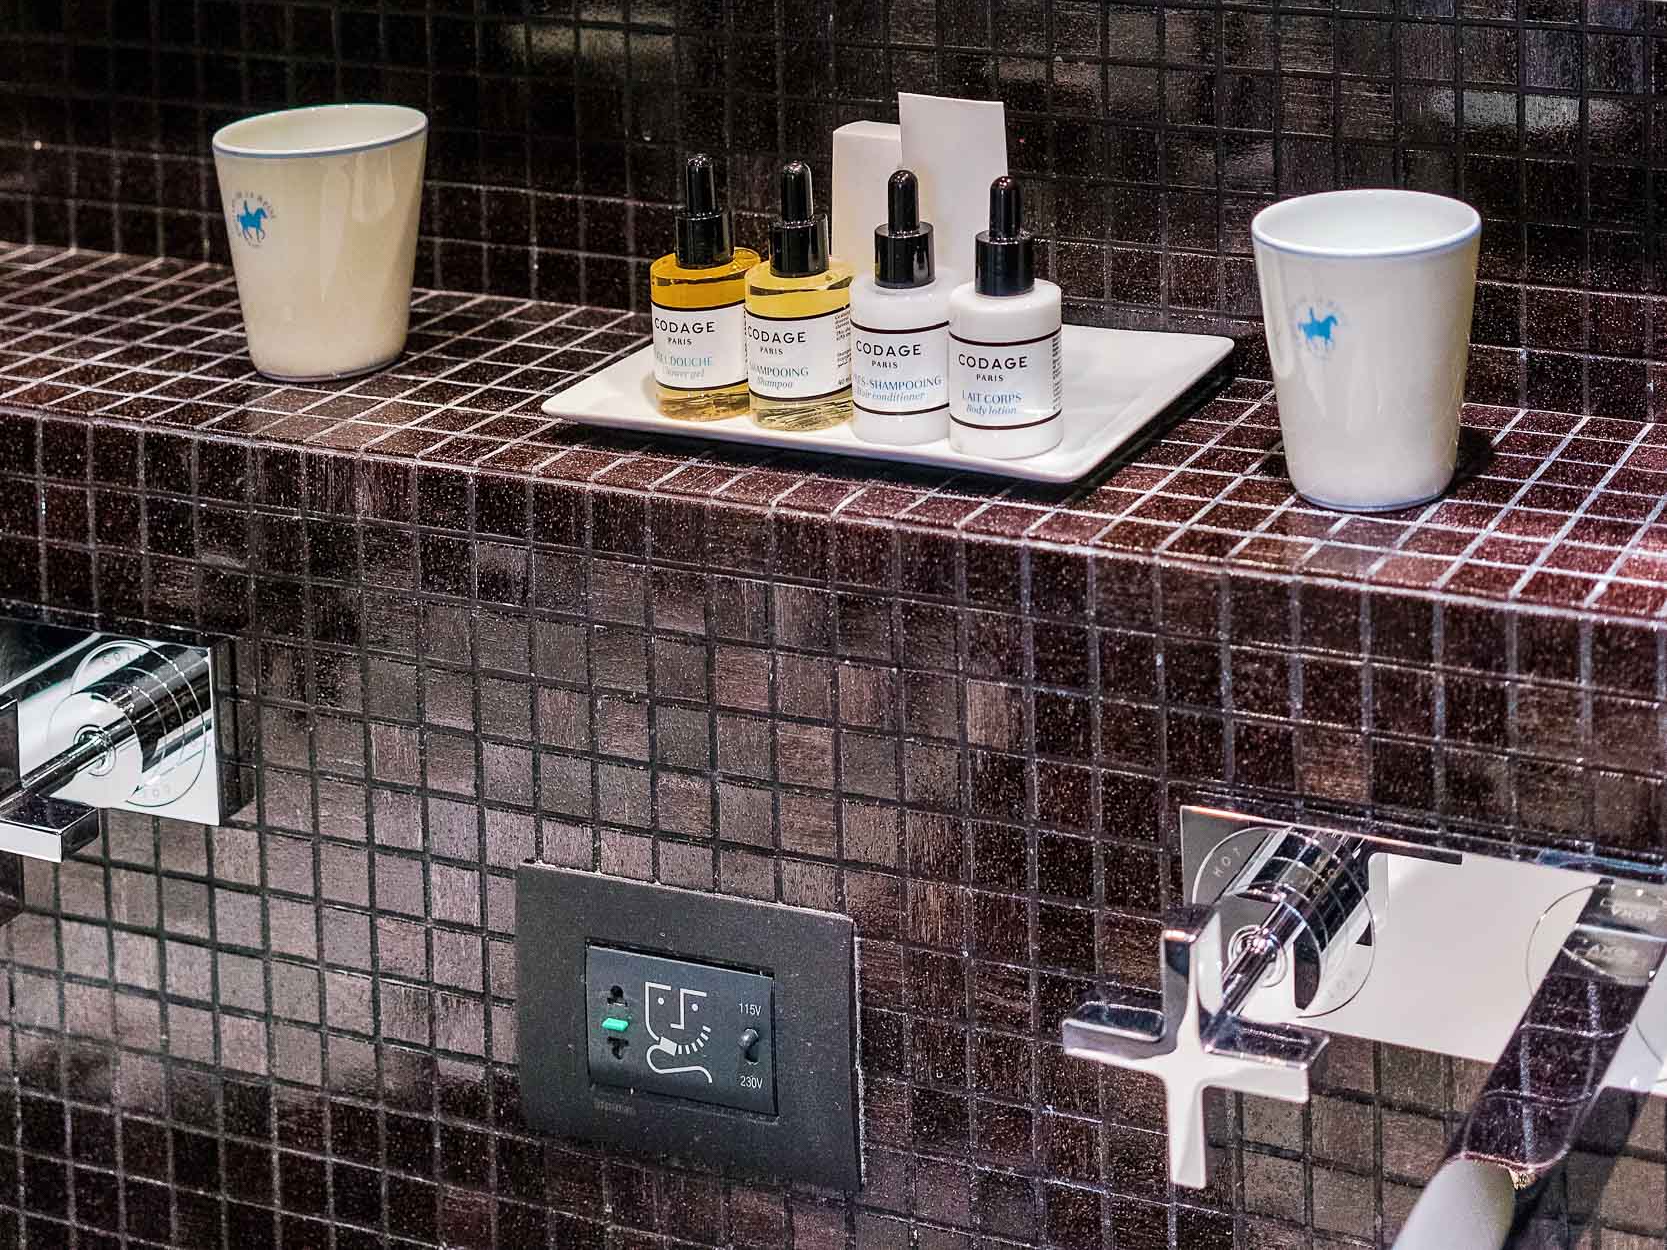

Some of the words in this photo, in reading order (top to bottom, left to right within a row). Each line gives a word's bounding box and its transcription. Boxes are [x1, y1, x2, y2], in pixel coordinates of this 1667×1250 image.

[654, 318, 716, 334] CODAGE
[748, 325, 807, 344] CODAGE
[668, 337, 692, 346] PARIS
[760, 347, 783, 355] PARIS
[855, 340, 922, 357] CODAGE
[670, 356, 713, 367] DOUCHE
[871, 360, 898, 369] PARIS
[958, 353, 1028, 370] CODAGE
[976, 373, 1004, 382] PARIS
[872, 391, 926, 403] conditioner
[962, 390, 982, 403] LAIT
[984, 393, 1022, 404] CORPS
[967, 404, 986, 416] Body
[988, 405, 1017, 415] lotion
[738, 1003, 761, 1016] 115V
[740, 1075, 763, 1089] 230V
